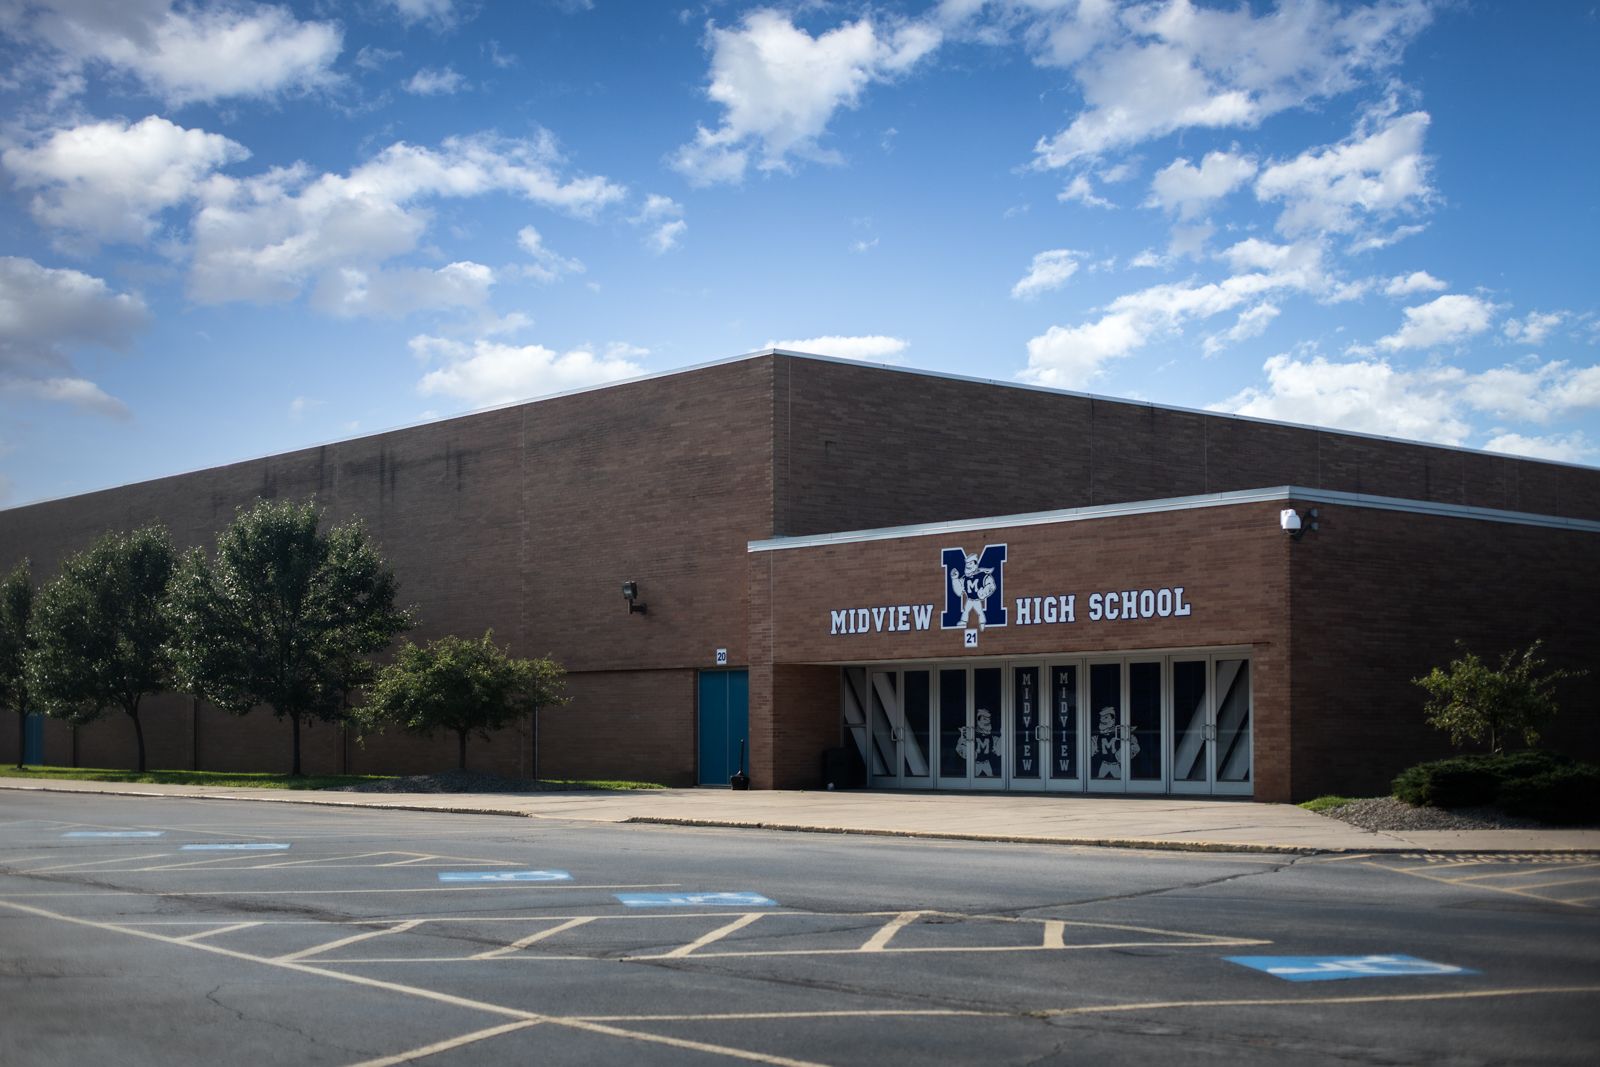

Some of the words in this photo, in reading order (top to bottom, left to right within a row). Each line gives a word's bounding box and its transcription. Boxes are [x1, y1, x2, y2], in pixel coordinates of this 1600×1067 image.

[941, 543, 1008, 630] M
[967, 578, 980, 594] M
[1015, 594, 1076, 626] HIGH
[1088, 586, 1191, 622] SCHOOL
[830, 604, 934, 635] MIDVIEW
[966, 632, 977, 644] 21
[717, 651, 726, 662] 20
[1022, 673, 1033, 771] MIDVIEW
[1059, 672, 1070, 771] MIDVIEW
[975, 737, 990, 755] M
[1101, 737, 1117, 755] M
